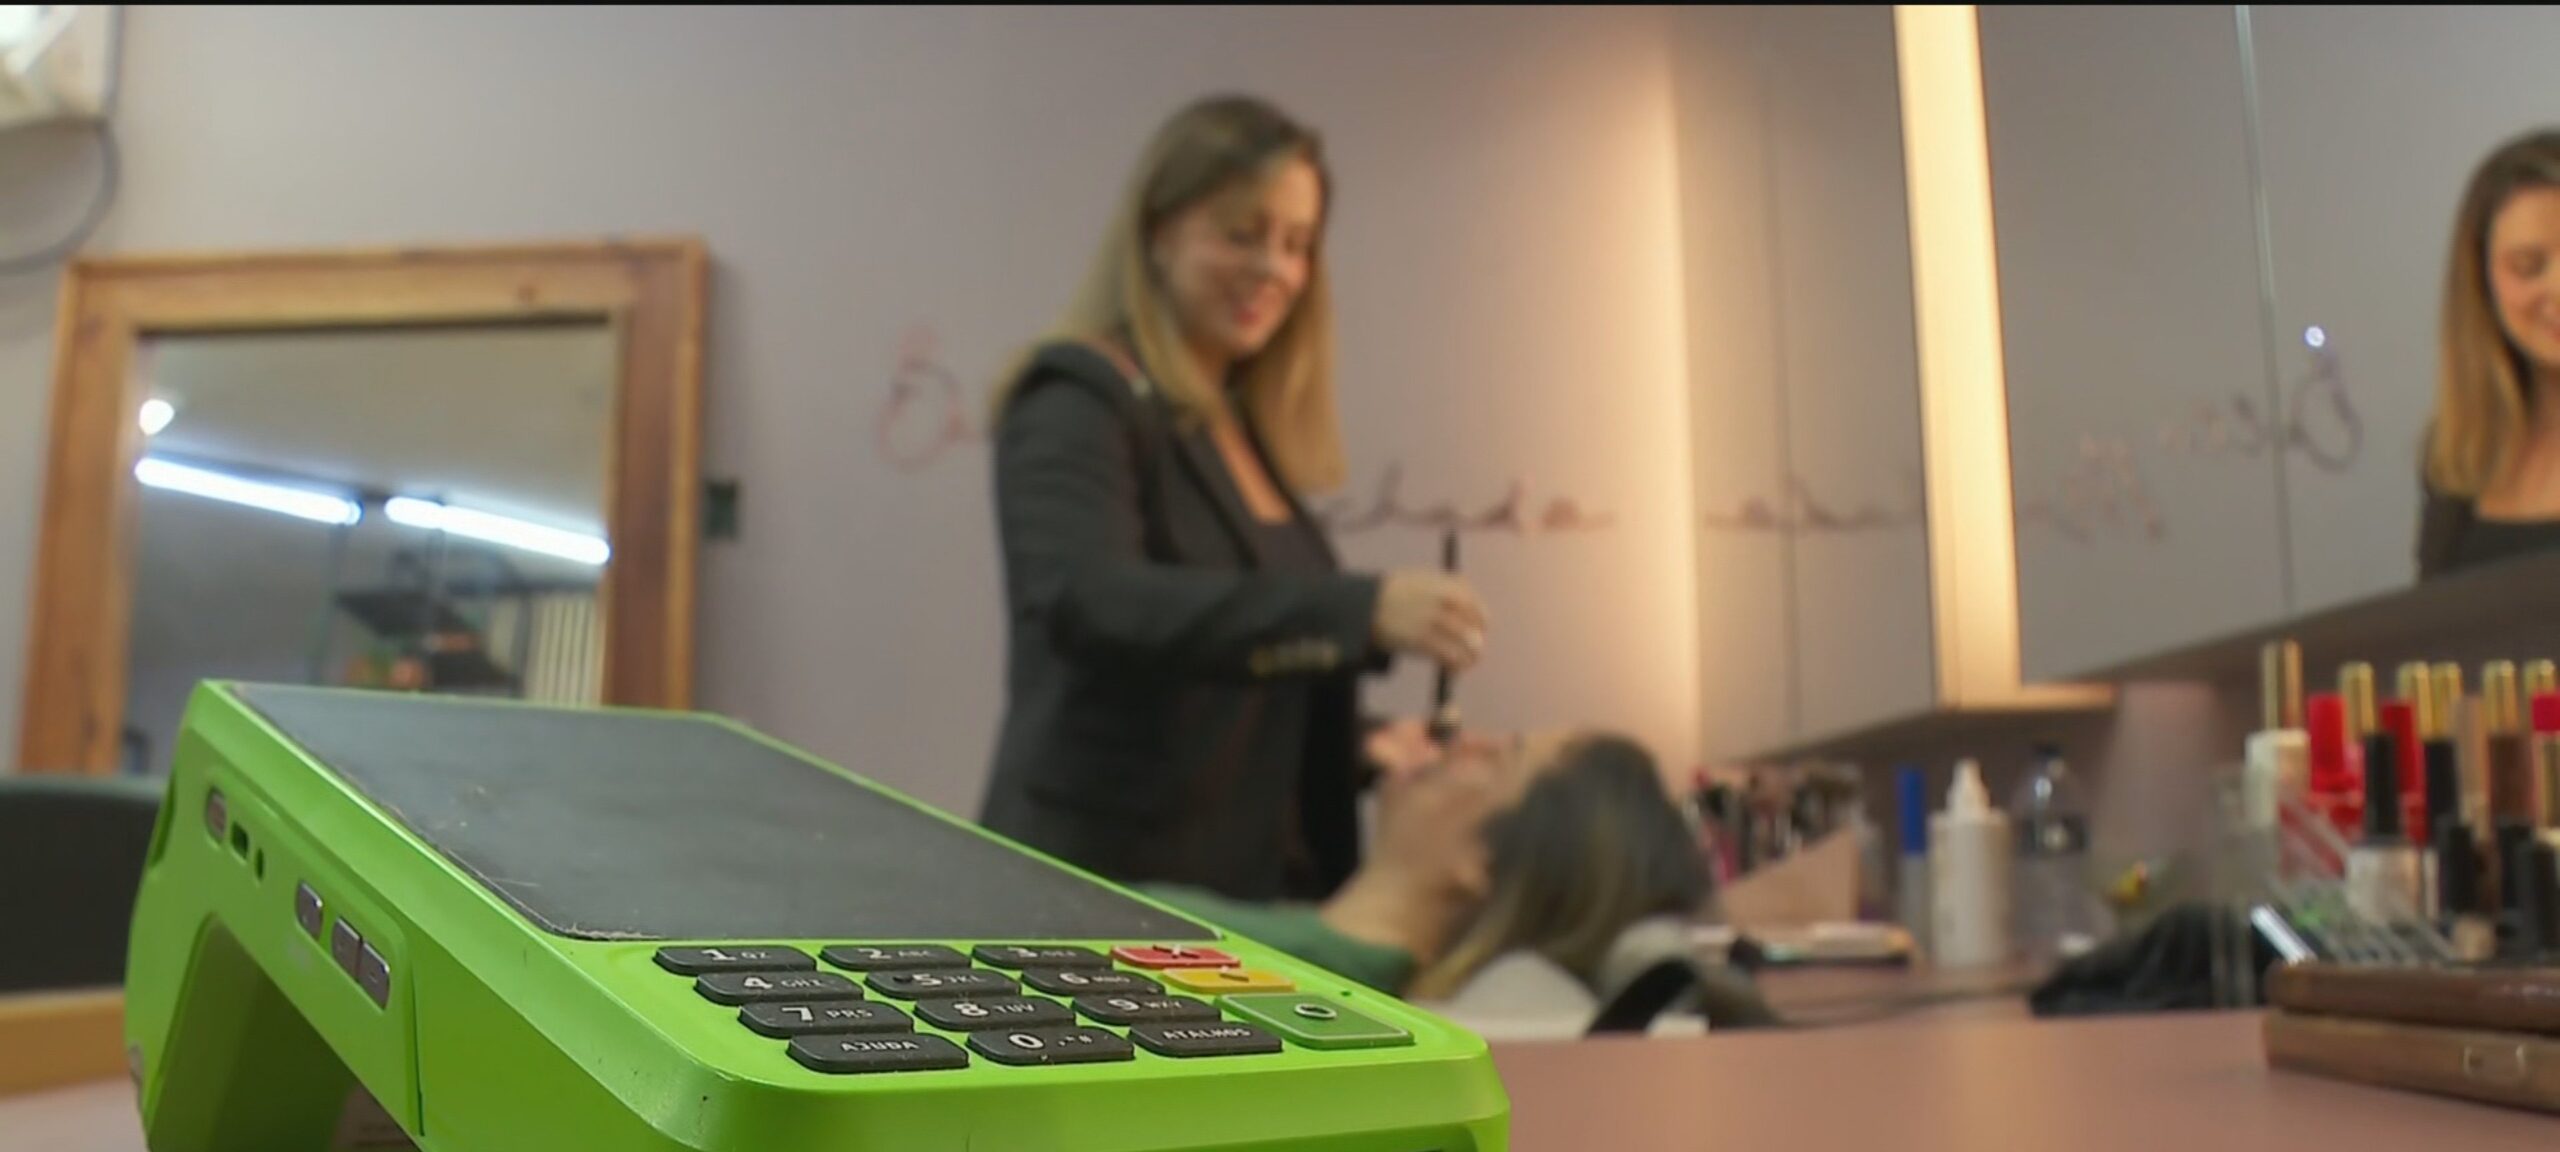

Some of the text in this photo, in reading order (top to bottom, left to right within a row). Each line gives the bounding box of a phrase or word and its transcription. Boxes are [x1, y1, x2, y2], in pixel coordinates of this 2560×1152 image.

[700, 949, 737, 961] 1
[857, 948, 892, 960] 2
[1006, 946, 1039, 958] 3
[743, 976, 774, 990] 4
[912, 973, 943, 987] 5
[1059, 972, 1091, 985] 6
[953, 1002, 1036, 1017] 8 TUV
[1107, 998, 1141, 1012] 9
[781, 1006, 874, 1021] 7 PRS
[840, 1041, 919, 1052] AJUDA
[1008, 1033, 1045, 1050] 0
